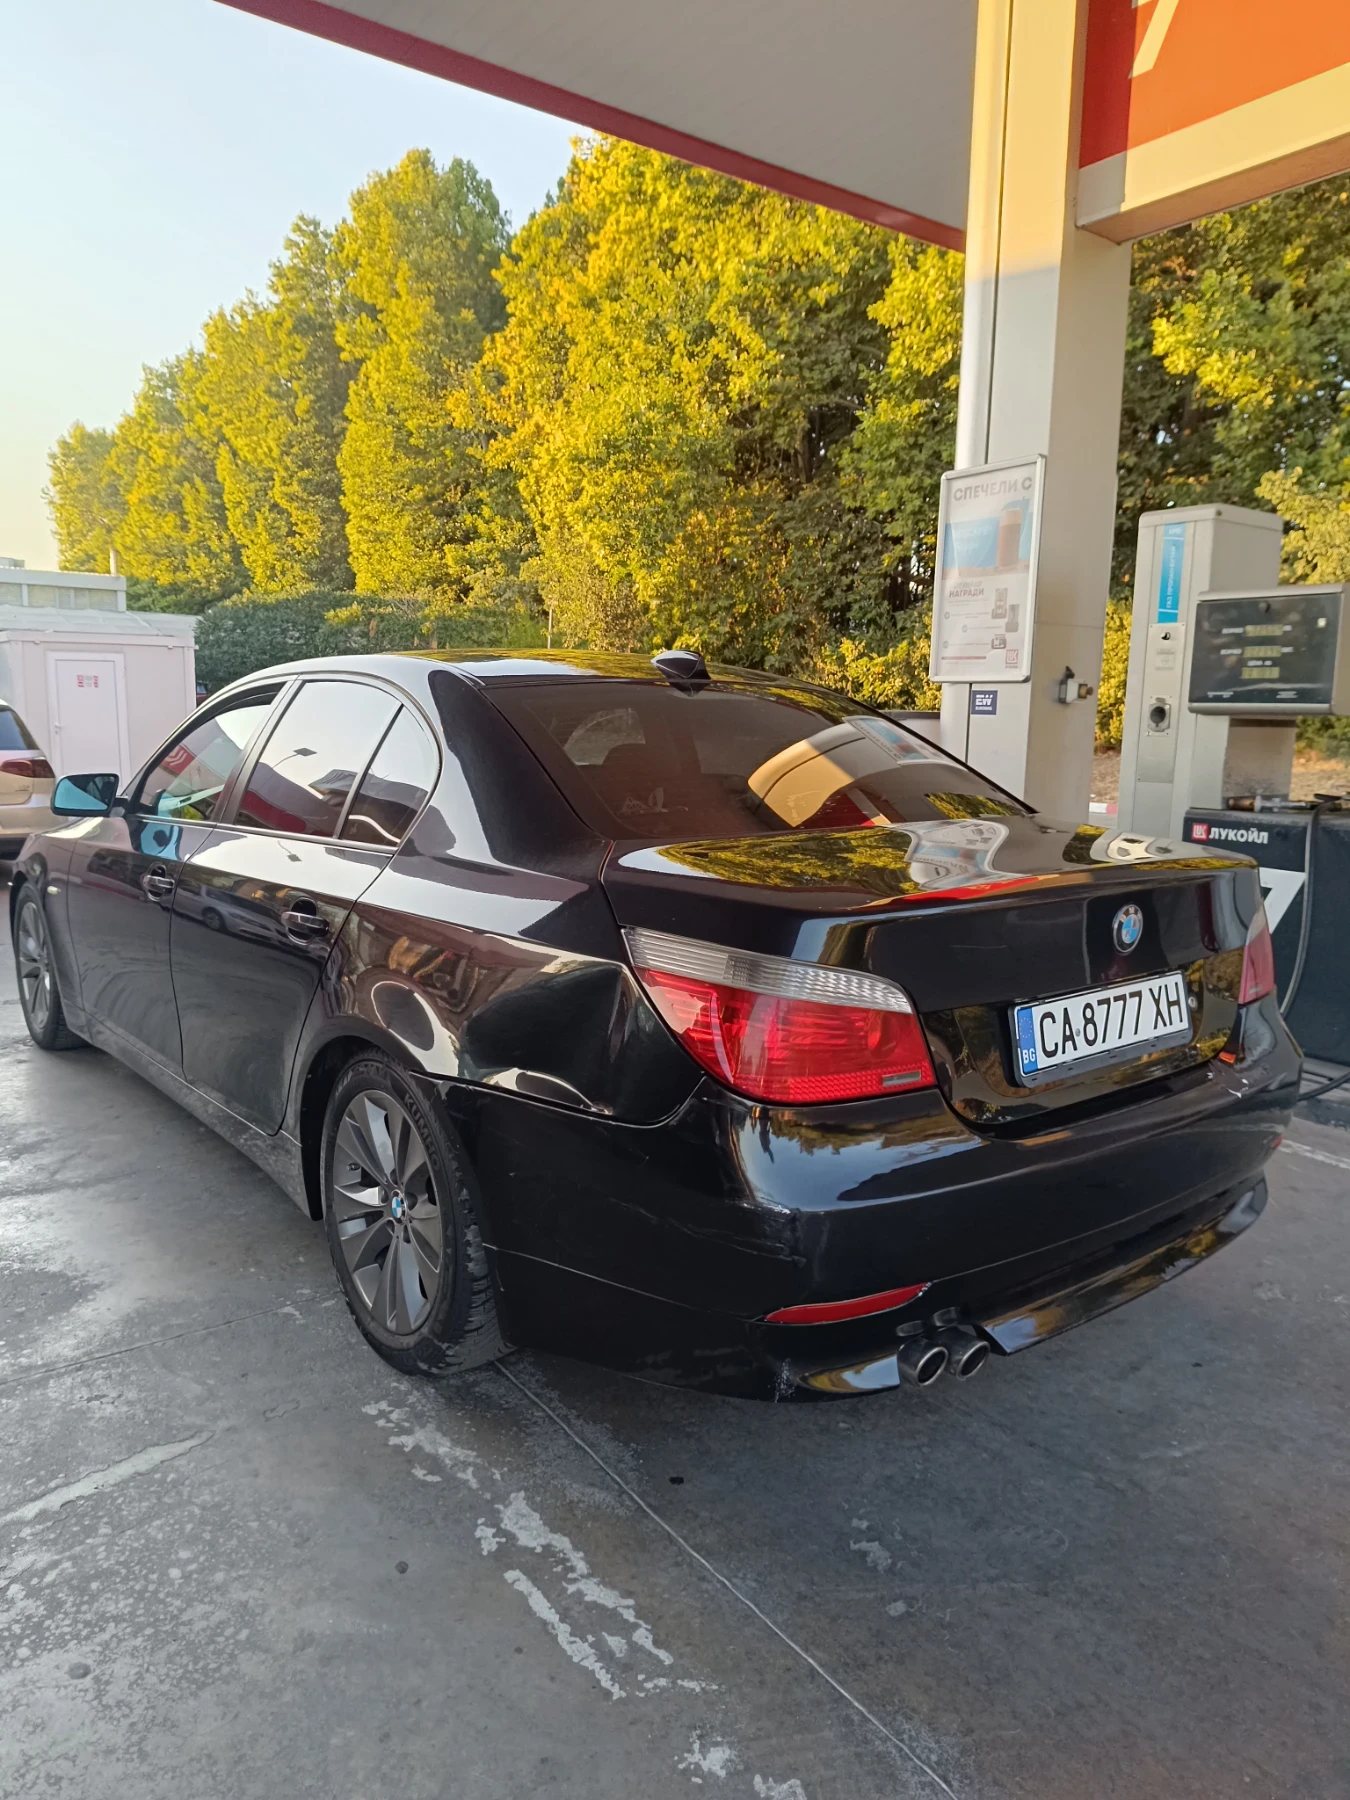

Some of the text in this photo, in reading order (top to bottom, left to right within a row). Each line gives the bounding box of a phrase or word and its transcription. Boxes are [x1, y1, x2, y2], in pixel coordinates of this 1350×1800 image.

[953, 476, 1033, 501] СПЕЧЕЛИ С
[949, 588, 985, 598] НАГРАДИ
[1209, 827, 1269, 844] ЛУКОЙЛ
[1039, 982, 1183, 1059] CA 8777 XH
[1022, 1050, 1036, 1064] BG
[403, 1092, 440, 1171] KUMHO
